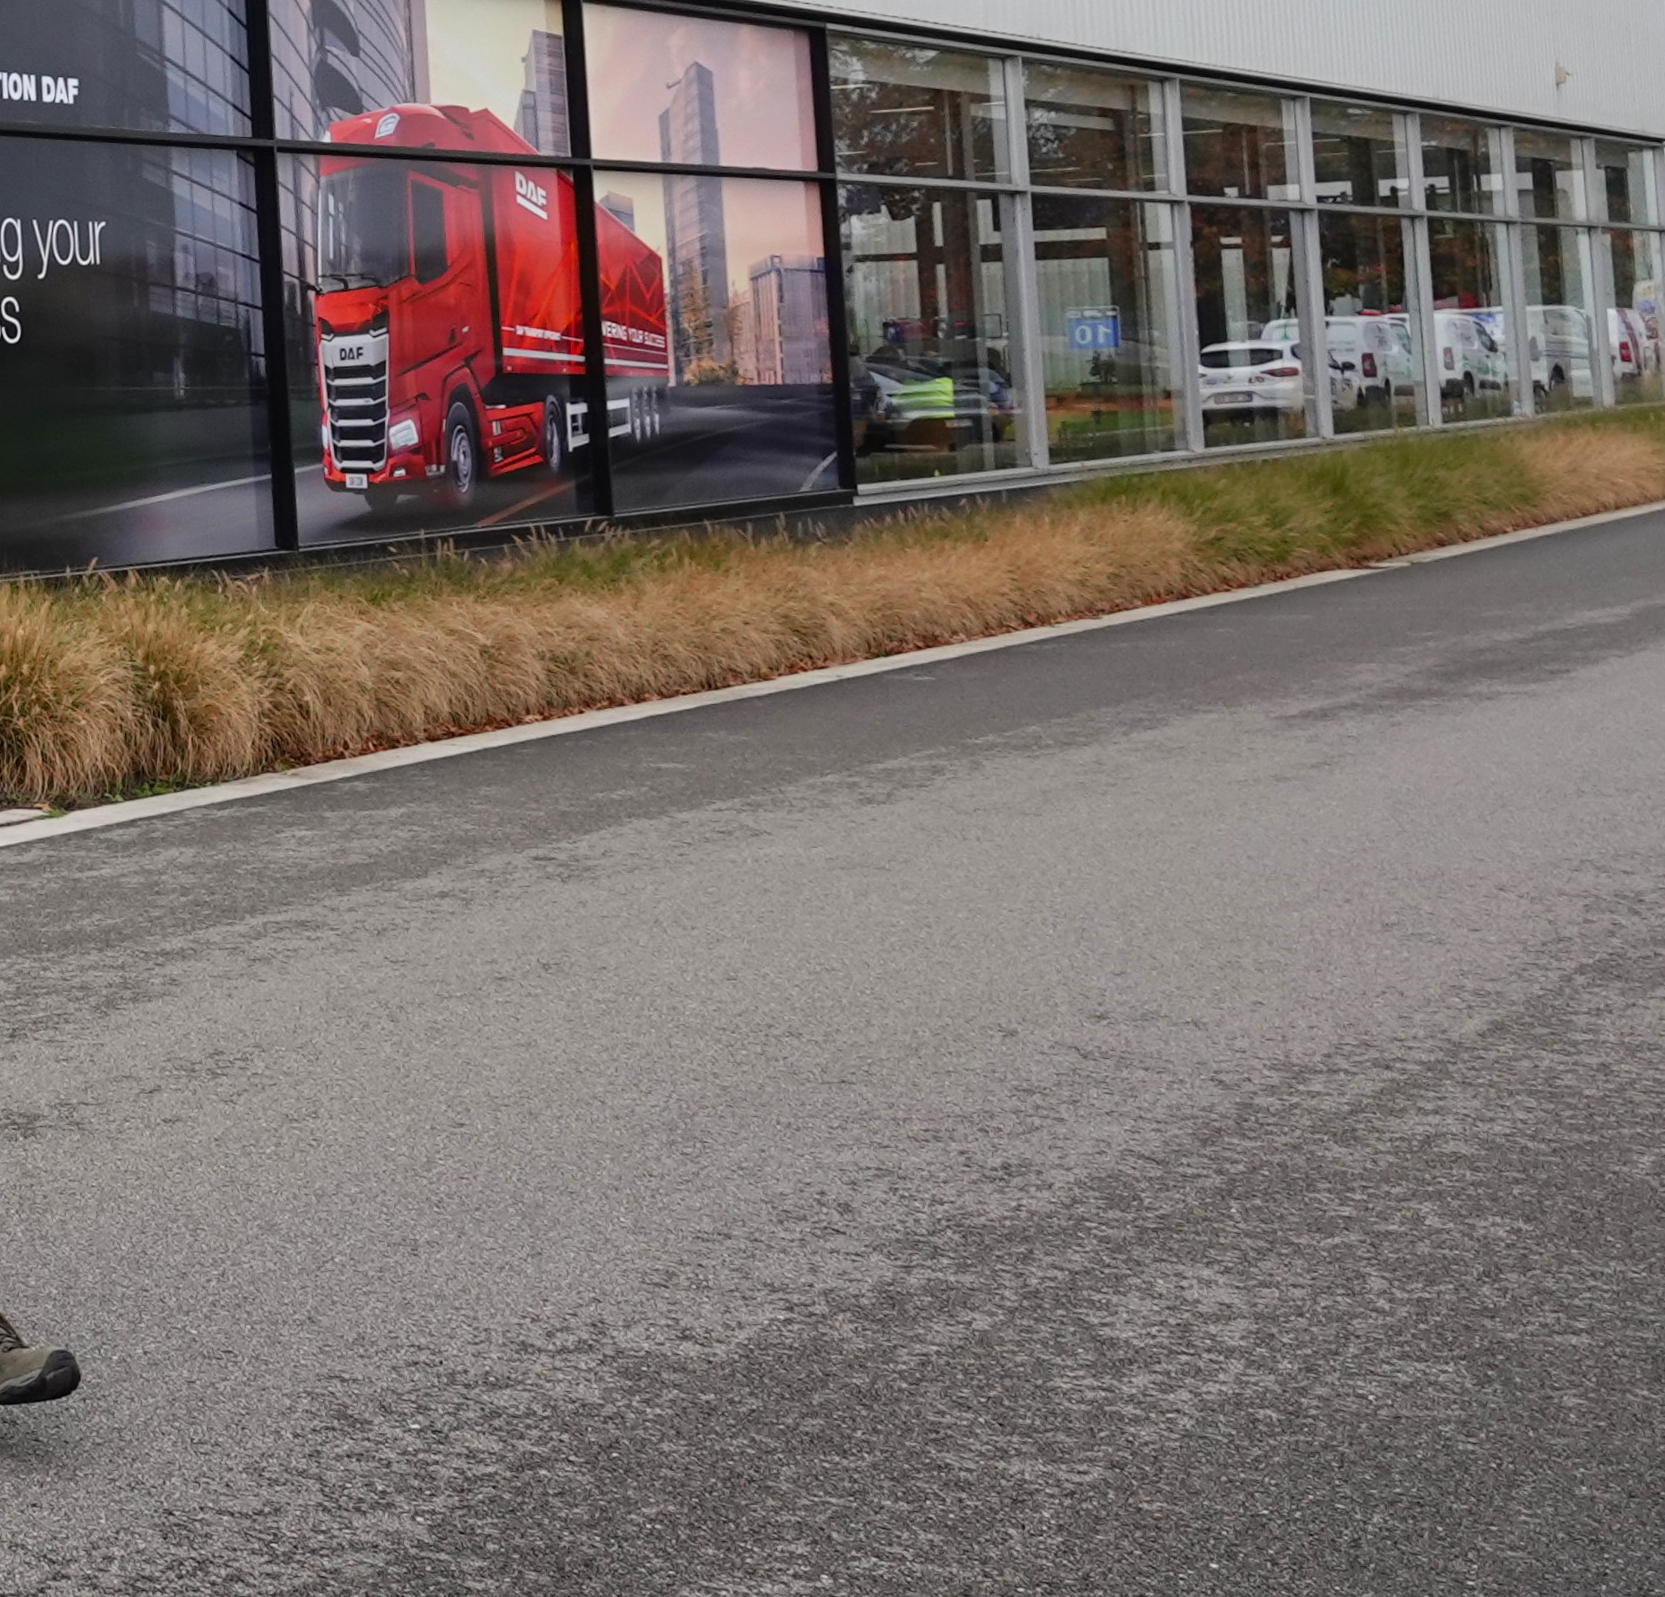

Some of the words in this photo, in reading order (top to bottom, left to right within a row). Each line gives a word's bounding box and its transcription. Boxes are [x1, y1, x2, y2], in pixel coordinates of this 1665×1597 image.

[41, 76, 79, 104] DAF
[515, 170, 547, 207] DAF
[32, 219, 106, 280] your
[339, 346, 364, 361] DAF
